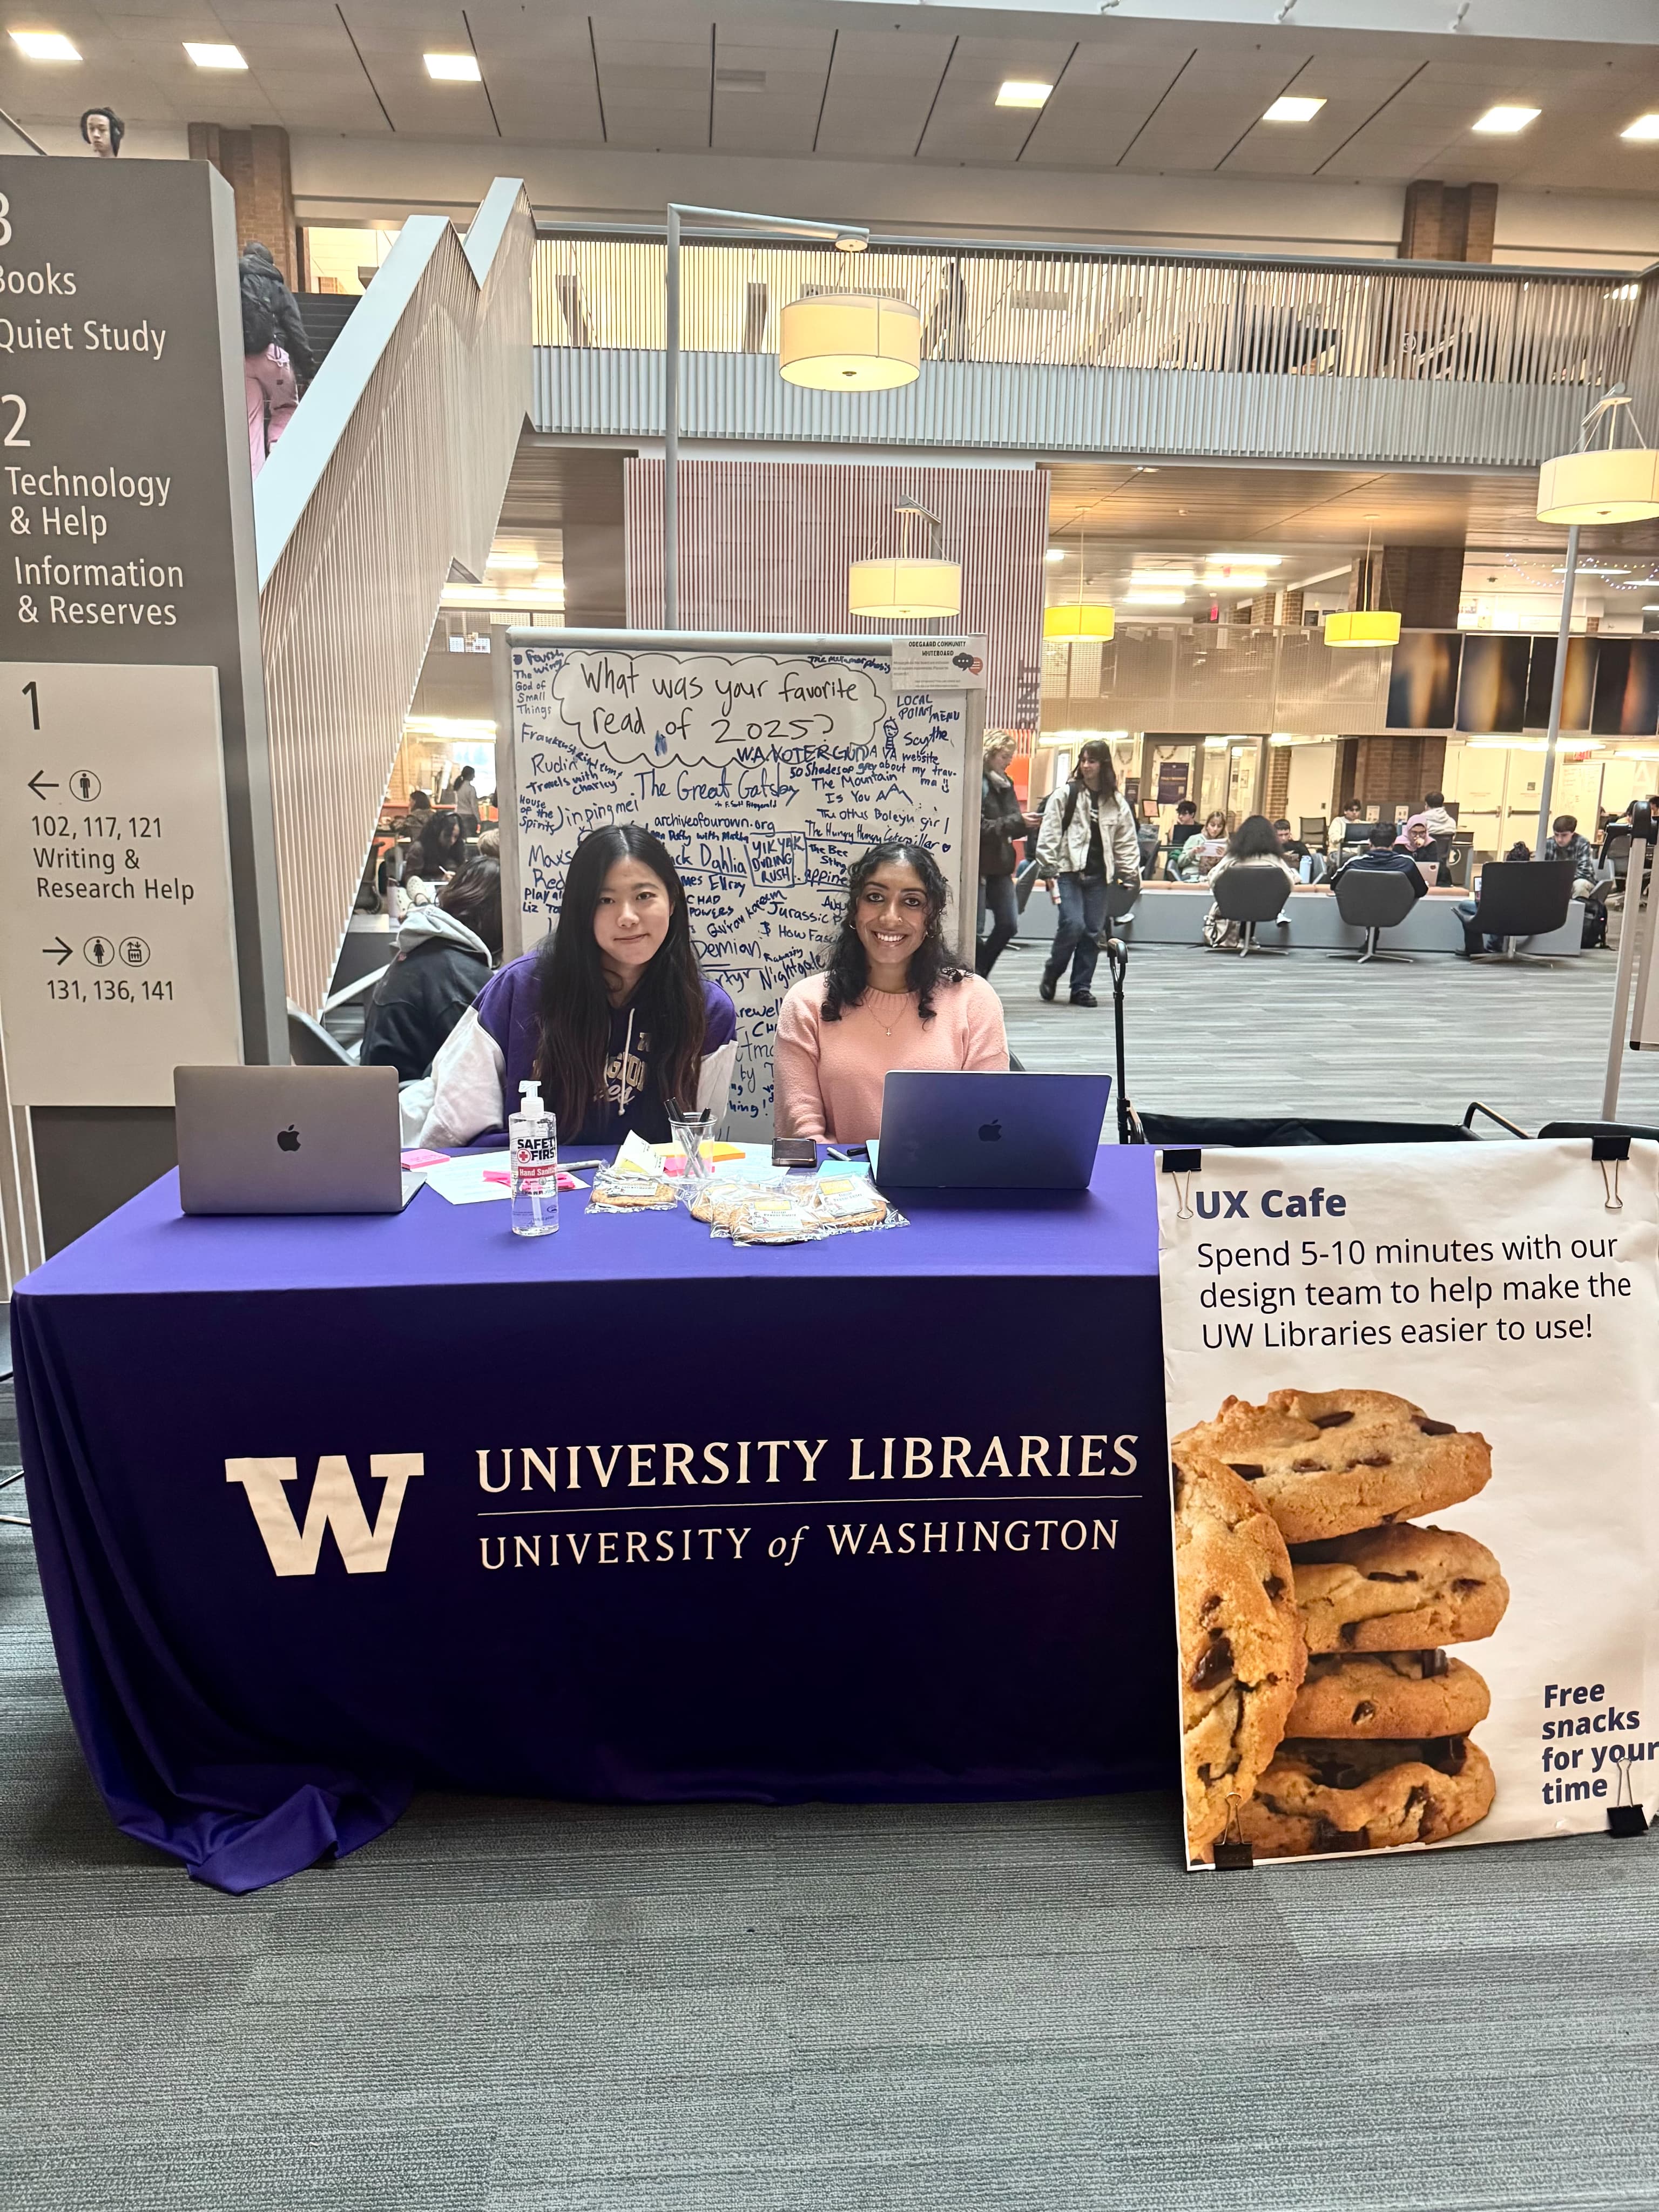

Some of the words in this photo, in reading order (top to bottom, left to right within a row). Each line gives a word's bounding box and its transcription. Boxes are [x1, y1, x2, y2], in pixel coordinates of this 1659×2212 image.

[0, 319, 73, 354] Quiet
[84, 320, 166, 360] Study
[1, 394, 31, 447] 2
[4, 466, 171, 506] Technology
[10, 505, 31, 535] &
[42, 505, 107, 544] Help
[15, 555, 183, 588] Information
[18, 595, 39, 623] &
[50, 596, 177, 625] Reserves
[513, 670, 532, 679] The
[515, 682, 532, 691] God
[537, 680, 546, 690] of
[517, 692, 545, 703] Small
[580, 657, 639, 698] What
[652, 676, 703, 699] was
[715, 678, 768, 717] your
[778, 672, 858, 702] favorite
[22, 681, 41, 730] 1
[516, 705, 551, 719] Things
[897, 694, 933, 707] LOCAL
[594, 706, 646, 735] read
[665, 707, 693, 739] of
[711, 714, 834, 743] 2025?
[899, 705, 933, 720] POINT
[929, 711, 960, 723] MENU
[904, 726, 949, 755] Scythe
[531, 753, 578, 776] Rudin
[880, 759, 906, 773] about
[913, 766, 926, 778] my
[902, 751, 939, 766] website
[634, 768, 670, 800] The
[677, 767, 732, 800] Great
[790, 767, 803, 779] 50
[812, 777, 835, 791] The
[842, 771, 897, 788] Mountain
[920, 778, 937, 787] ma
[825, 792, 843, 804] Is
[851, 790, 870, 802] You
[537, 807, 554, 819] the
[874, 808, 914, 826] Boleyn
[31, 815, 77, 840] 102,
[83, 817, 120, 840] 117,
[128, 818, 162, 838] 121
[33, 847, 115, 874] Writing
[125, 849, 140, 869] &
[828, 845, 848, 857] Bee
[761, 867, 790, 883] RUSH
[37, 878, 135, 899] Research
[145, 878, 194, 905] Help
[525, 888, 550, 903] Play
[687, 895, 720, 905] CHAD
[523, 901, 539, 913] Liz
[690, 906, 734, 919] POWERS
[768, 901, 829, 924] Jurassic
[779, 924, 806, 940] How
[690, 939, 761, 959] Demian
[47, 980, 87, 1003] 131,
[94, 980, 134, 1003] 136,
[141, 981, 174, 1001] 141
[530, 1147, 555, 1161] FIRS
[1196, 1189, 1249, 1219] UX
[1260, 1186, 1347, 1219] Cafe
[1197, 1239, 1290, 1274] Spend
[1300, 1239, 1365, 1266] 5-10
[1375, 1237, 1493, 1265] minutes
[1502, 1233, 1561, 1261] with
[1570, 1235, 1618, 1259] our
[1200, 1283, 1297, 1314] design
[1304, 1281, 1382, 1306] team
[1391, 1279, 1420, 1305] to
[1429, 1276, 1493, 1309] help
[1502, 1272, 1580, 1301] make
[1587, 1271, 1633, 1298] the
[1202, 1323, 1255, 1350] UW
[1264, 1319, 1392, 1347] Libraries
[1401, 1317, 1488, 1344] easier
[1496, 1317, 1526, 1341] to
[1535, 1313, 1593, 1340] use!
[476, 1439, 828, 1493] UNIVERSITY
[849, 1434, 1138, 1480] LIBRARIES
[225, 1453, 424, 1577] W
[478, 1527, 751, 1570] UNIVERSITY
[768, 1525, 810, 1567] of
[827, 1519, 1119, 1555] WASHINGTON
[1545, 1684, 1604, 1709] Free
[1542, 1706, 1640, 1740] snacks
[1541, 1746, 1583, 1772] for
[1591, 1741, 1659, 1773] your
[1542, 1777, 1608, 1805] time
